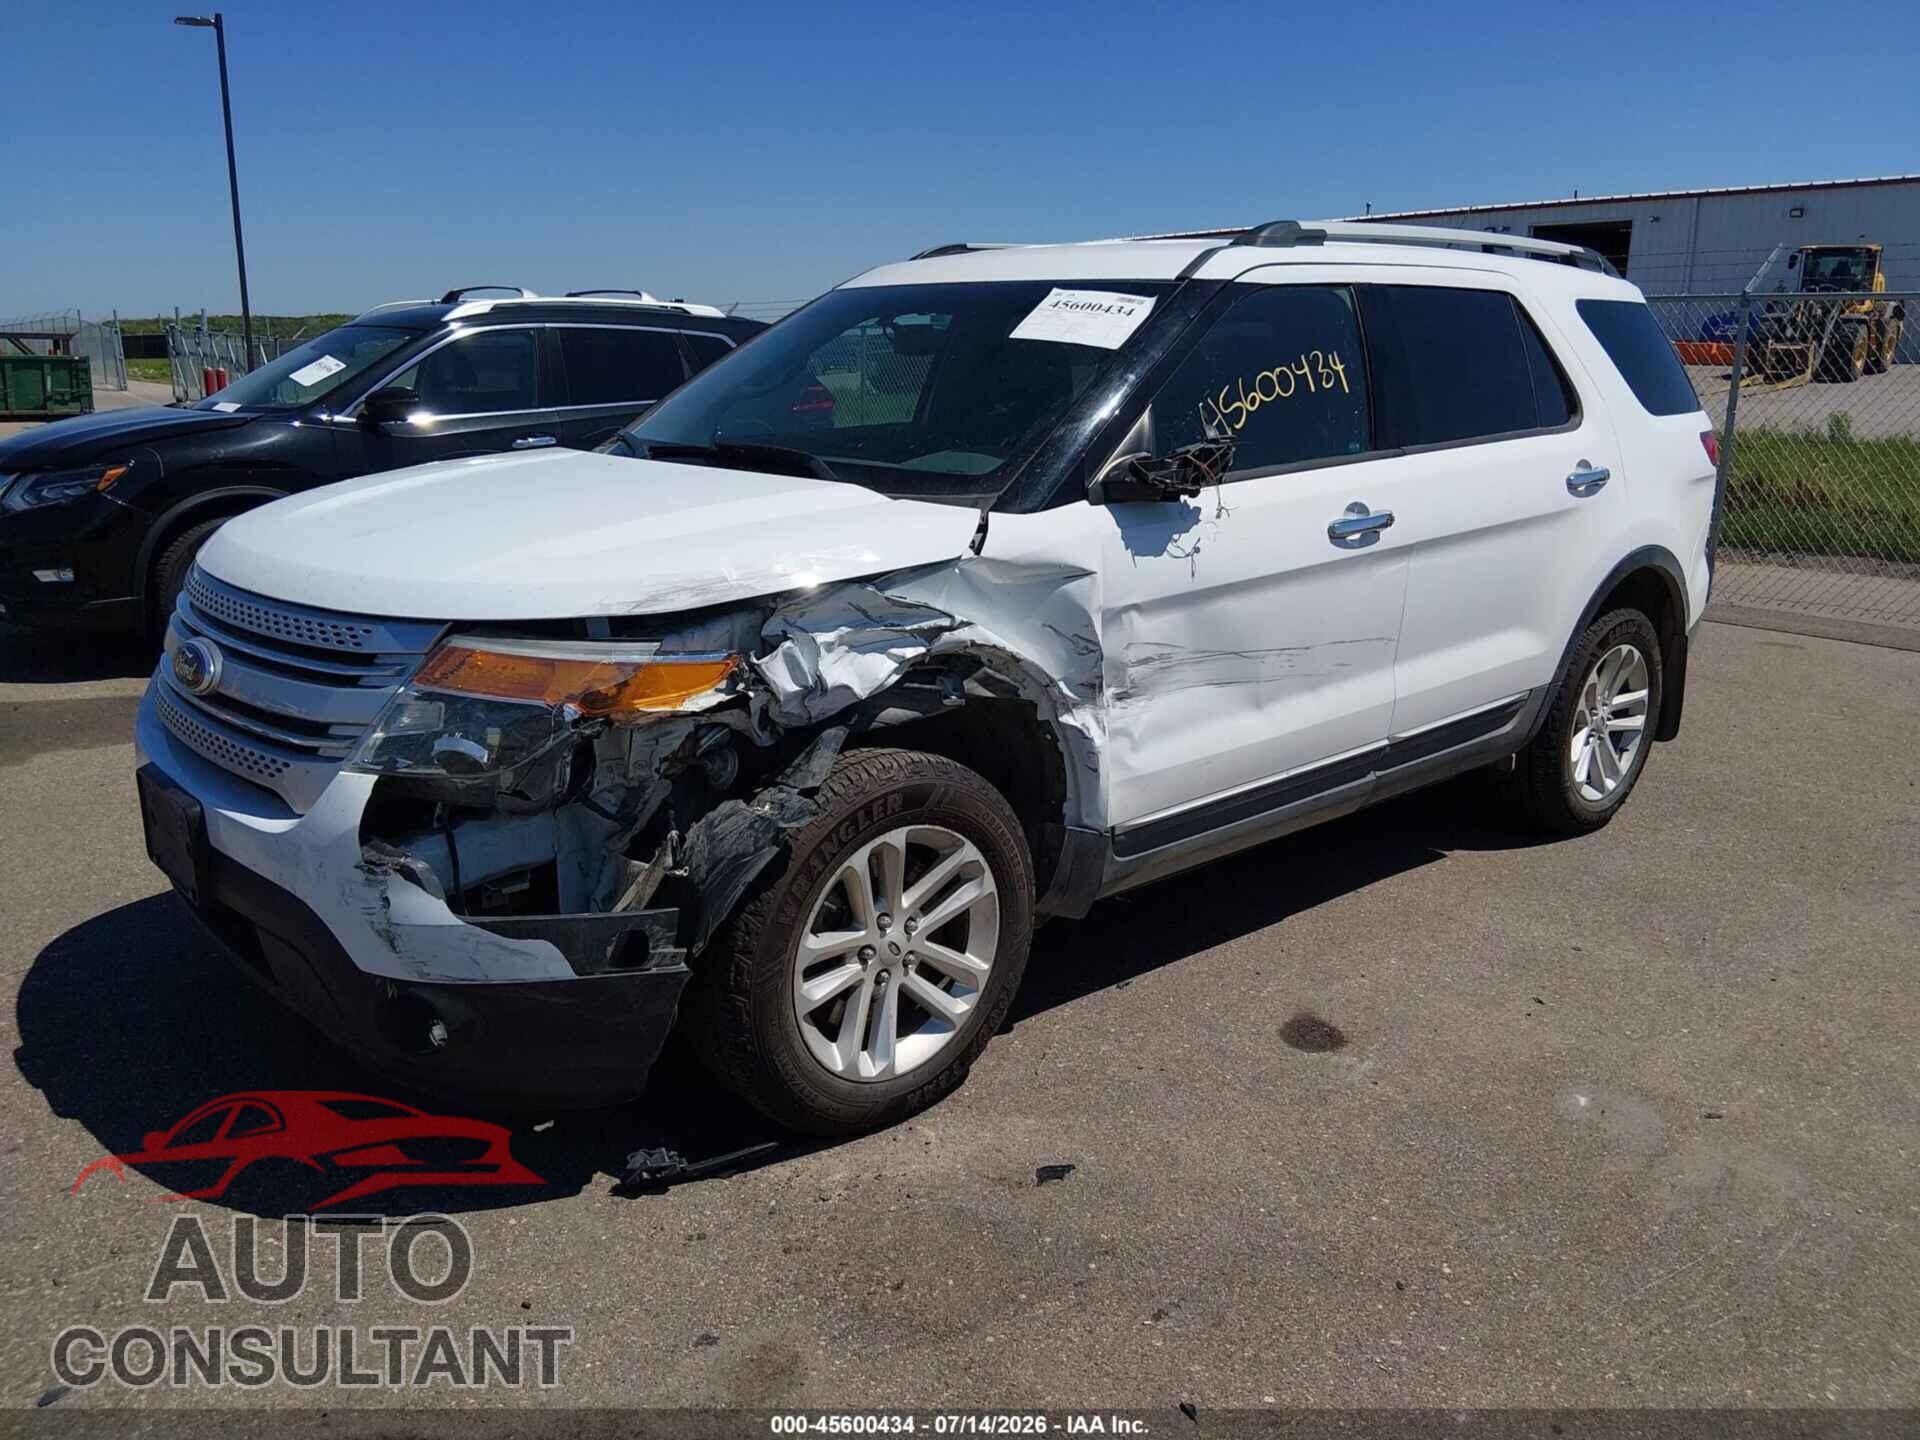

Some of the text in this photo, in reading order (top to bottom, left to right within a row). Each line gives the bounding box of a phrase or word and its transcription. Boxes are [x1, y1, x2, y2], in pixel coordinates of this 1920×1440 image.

[1049, 299, 1136, 317] 45600434
[1199, 350, 1350, 436] 45600434
[176, 648, 198, 681] Ford
